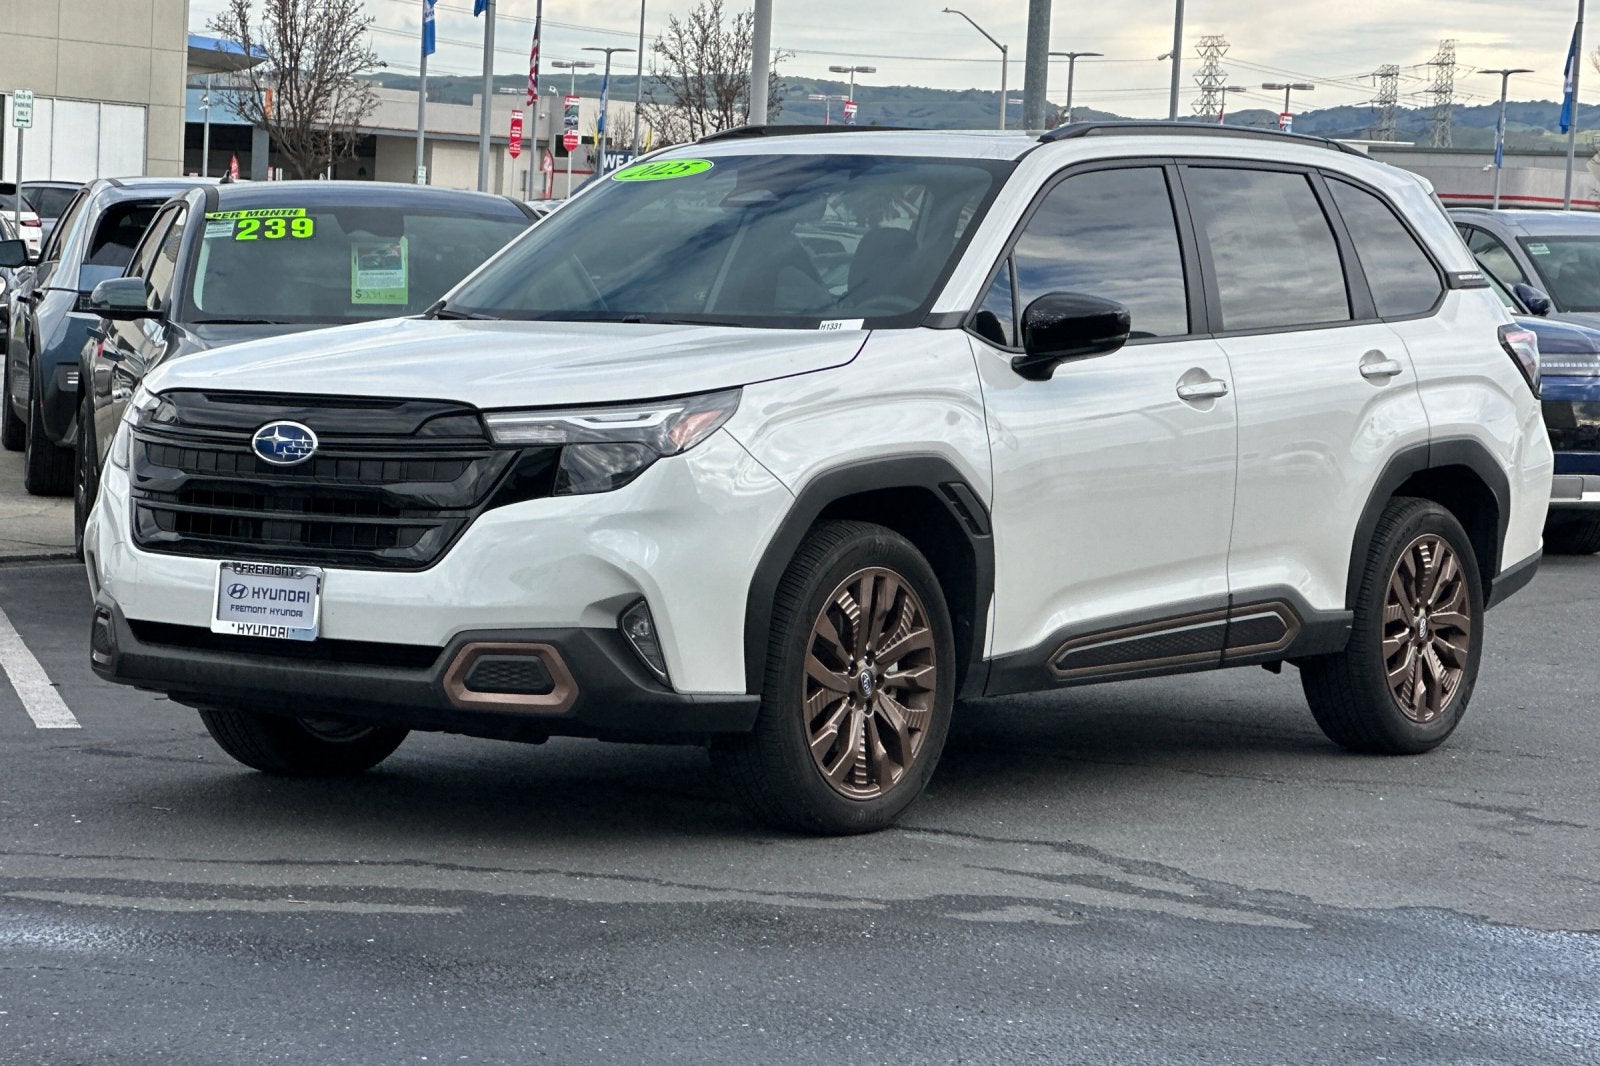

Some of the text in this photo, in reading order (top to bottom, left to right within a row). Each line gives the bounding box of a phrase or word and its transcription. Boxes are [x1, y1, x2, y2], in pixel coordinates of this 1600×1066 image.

[621, 161, 703, 178] 2025
[246, 209, 298, 217] MONTH
[235, 217, 314, 241] 239
[820, 322, 842, 331] H1331
[240, 563, 296, 577] FREMONT
[252, 586, 310, 603] HYUNDAI
[230, 604, 304, 618] FREMONT HYUNDAI
[236, 623, 289, 639] HYUNDAI
